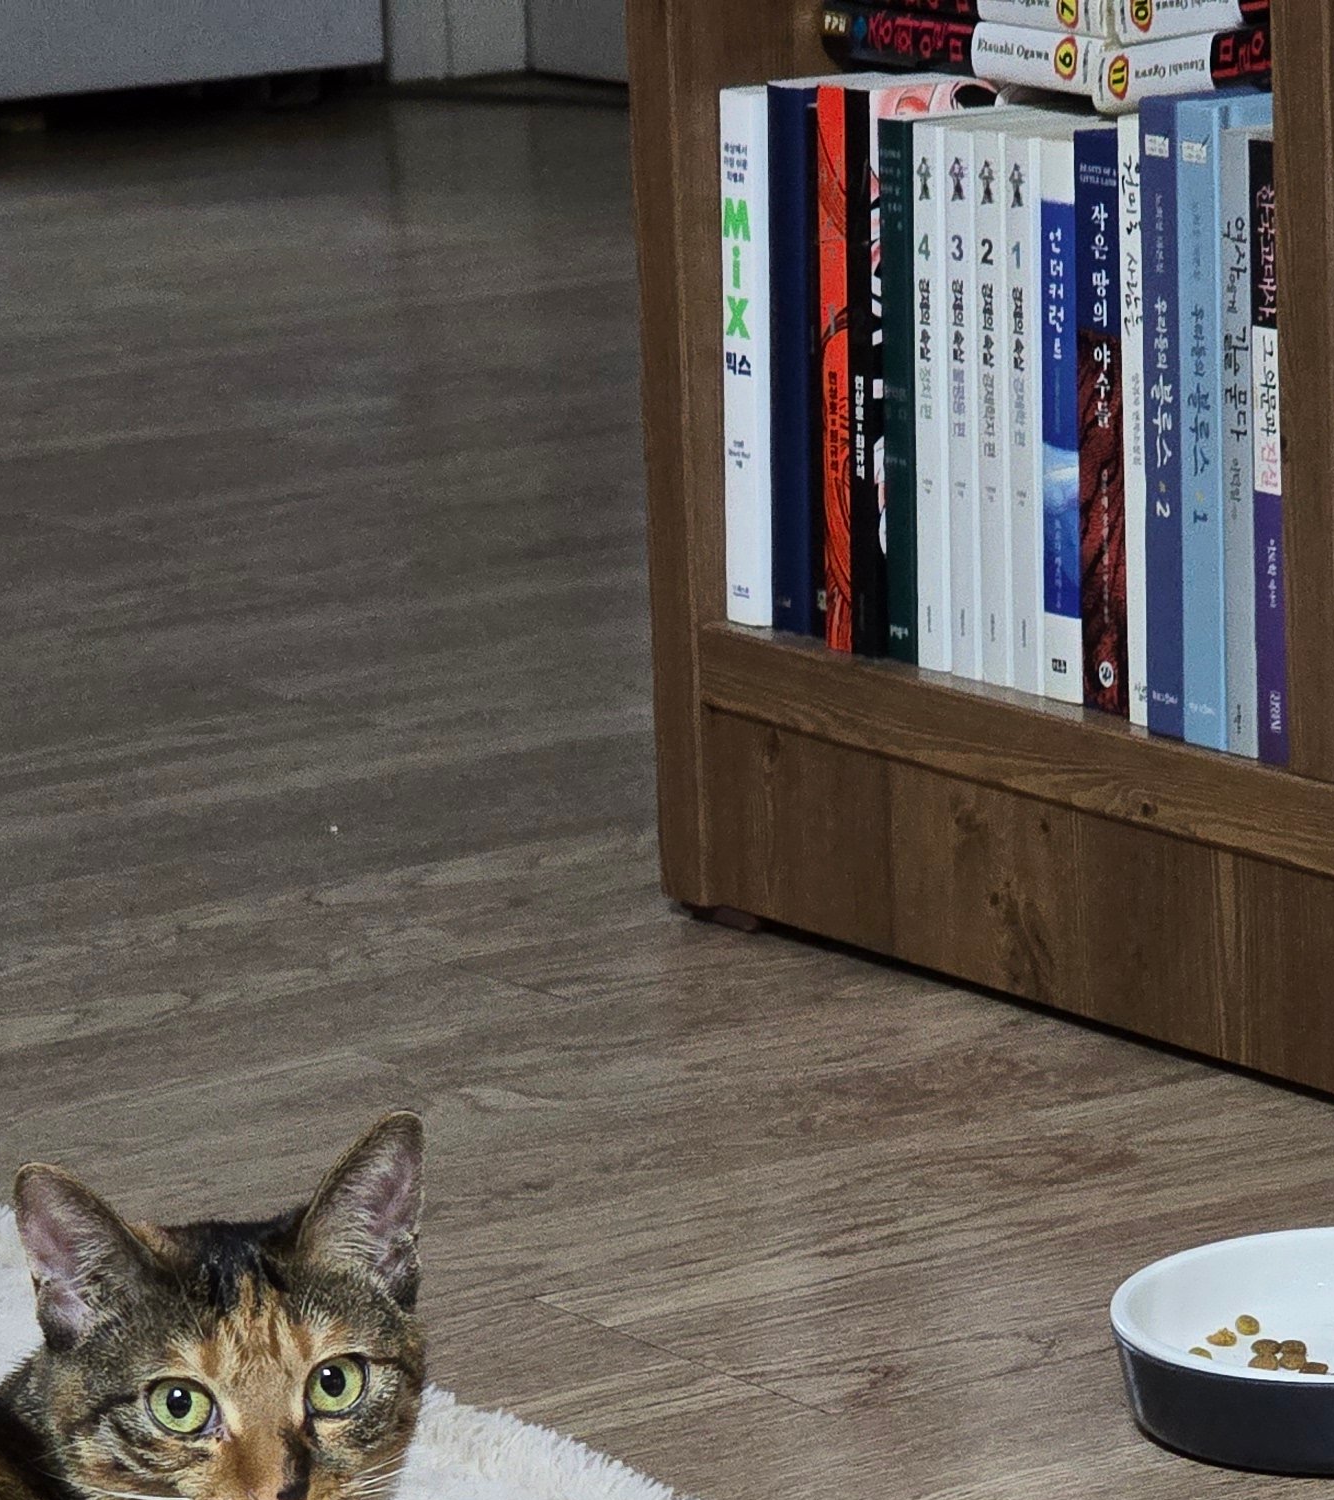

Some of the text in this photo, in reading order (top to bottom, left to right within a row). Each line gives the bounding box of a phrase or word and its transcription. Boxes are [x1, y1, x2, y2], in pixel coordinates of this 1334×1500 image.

[1016, 45, 1050, 60] Ogawa
[918, 234, 931, 261] 4
[951, 235, 963, 261] 3
[981, 238, 994, 265] 2
[1011, 241, 1021, 269] 1
[919, 278, 931, 325] 경제의
[952, 279, 964, 328] 경제의
[982, 283, 994, 332] 경제의
[1012, 287, 1024, 335] 경제의
[1048, 227, 1065, 360] 언더커런트
[1091, 202, 1111, 428] 작은 땅의 야수들
[725, 352, 752, 376] 믹스
[1151, 296, 1173, 469] 우리들의 블루스
[1188, 304, 1211, 477] 우리들의 블루스
[1224, 386, 1248, 443] 묻다
[1156, 502, 1171, 518] 2
